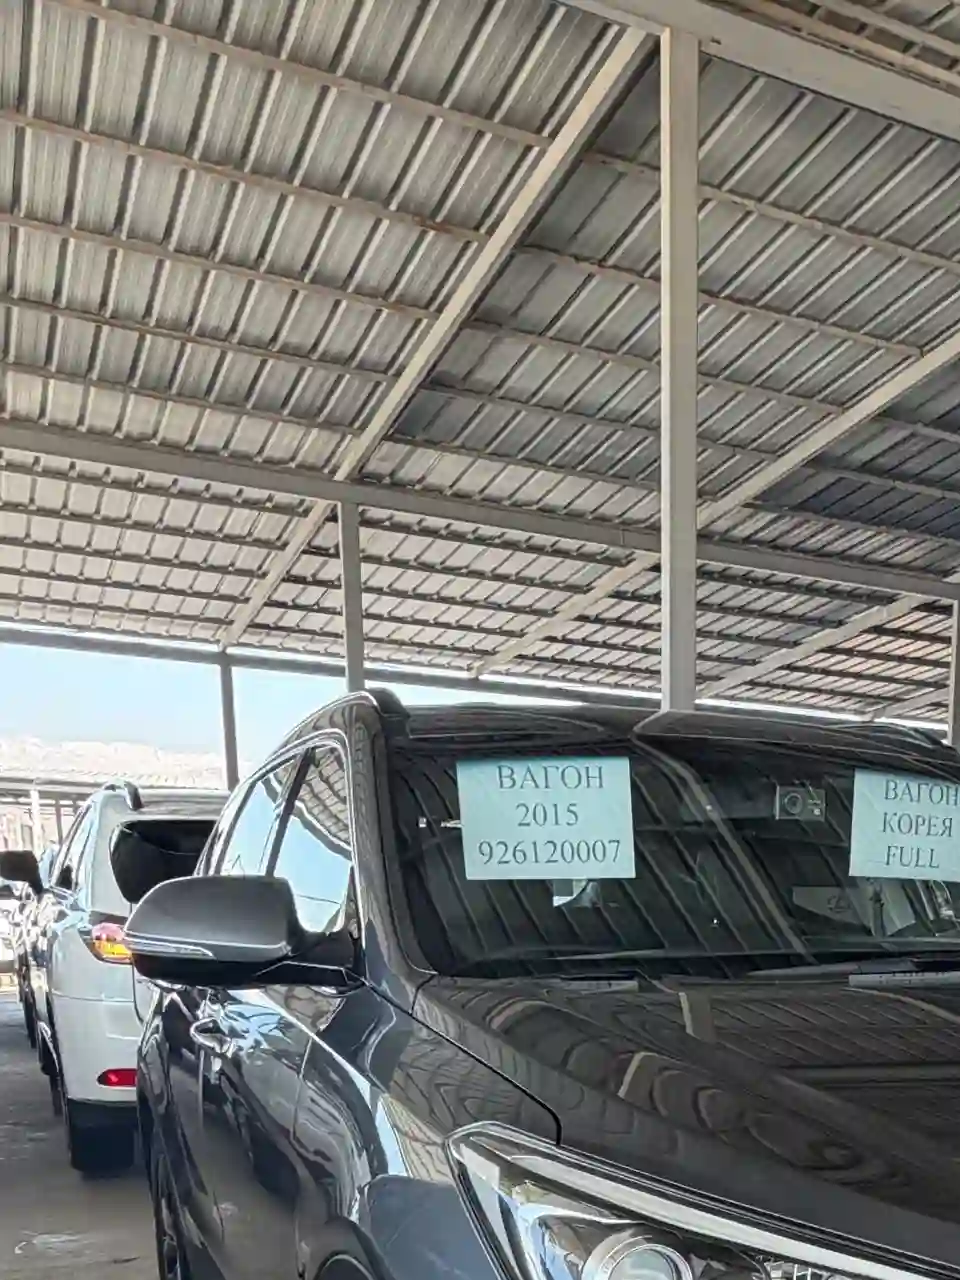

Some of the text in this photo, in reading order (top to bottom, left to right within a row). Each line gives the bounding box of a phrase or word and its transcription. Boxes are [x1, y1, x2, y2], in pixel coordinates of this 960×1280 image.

[497, 765, 604, 790] ВАГОН
[884, 779, 959, 806] ВАГОН
[515, 802, 579, 827] 2015
[882, 812, 953, 838] КОРЕЯ
[478, 839, 621, 865] 926120007
[885, 845, 940, 869] FULL
